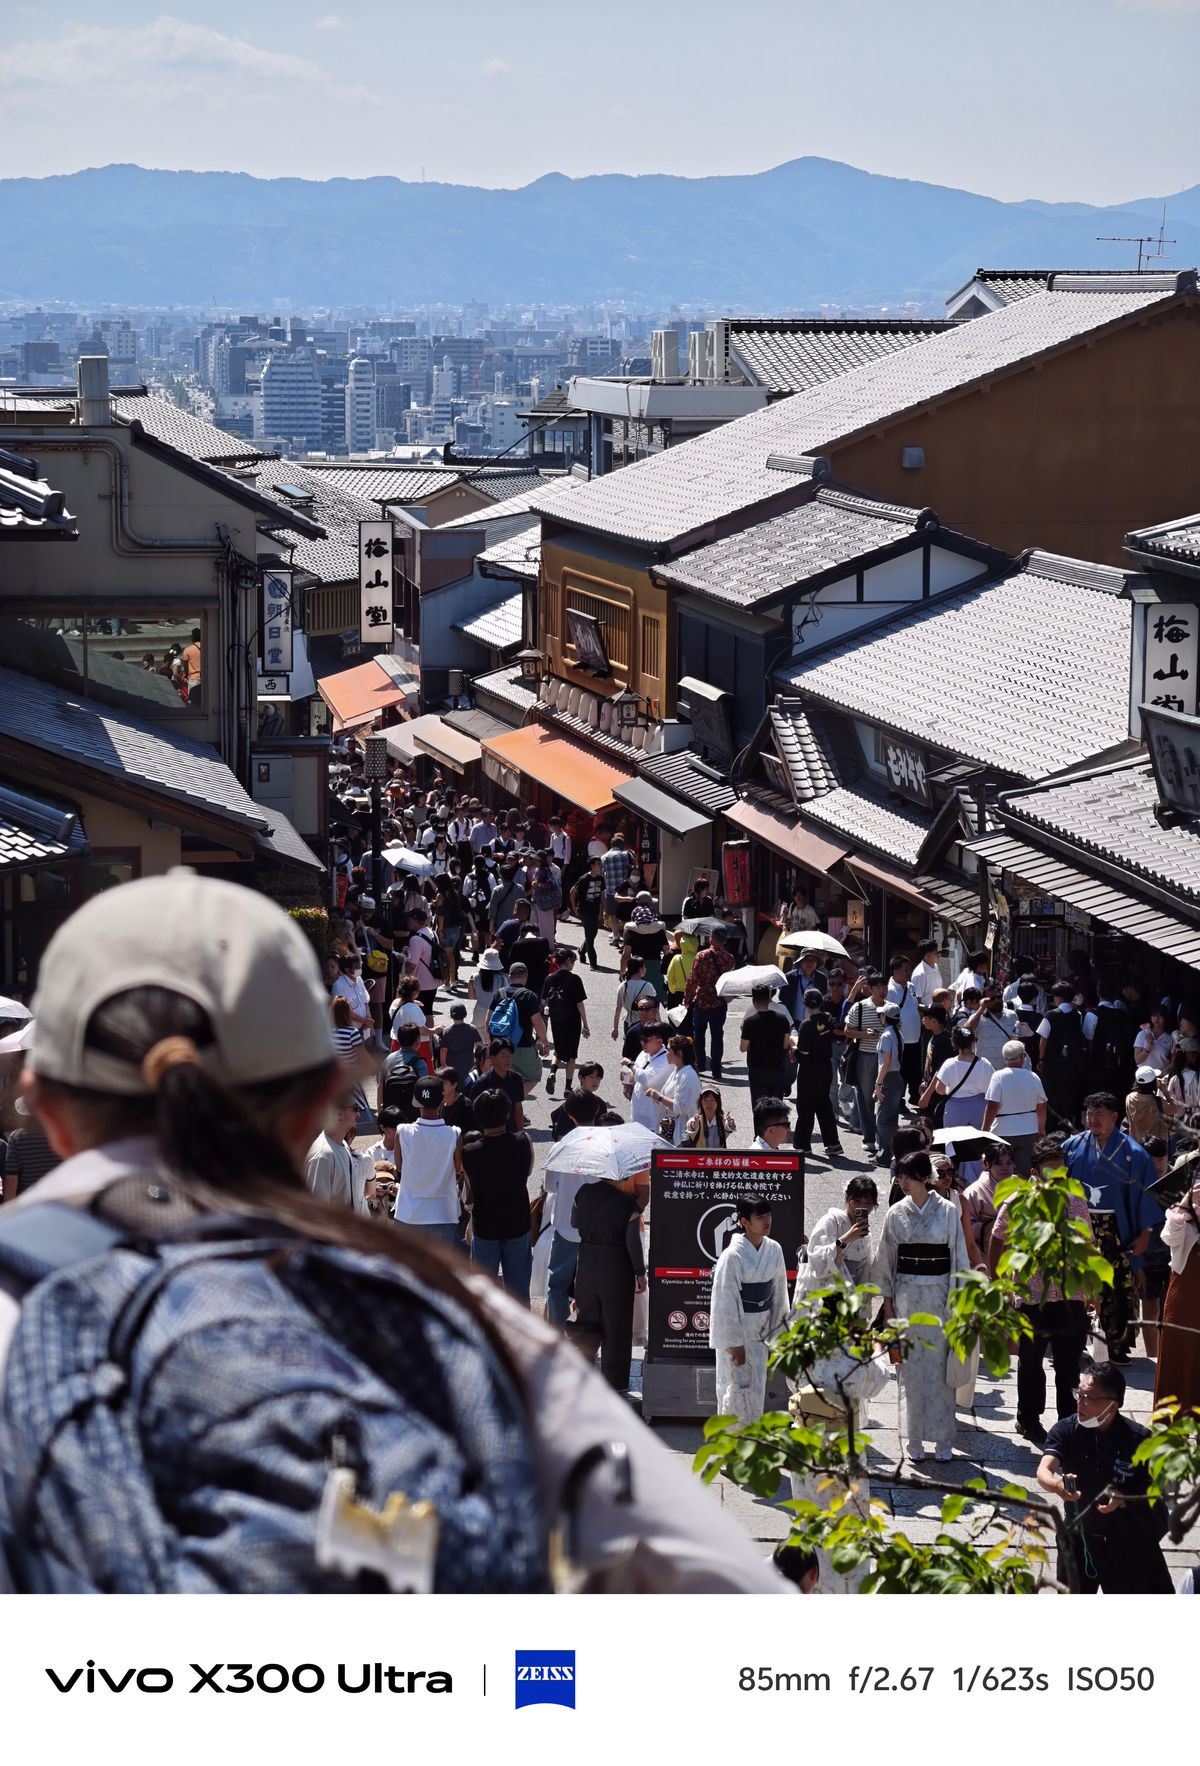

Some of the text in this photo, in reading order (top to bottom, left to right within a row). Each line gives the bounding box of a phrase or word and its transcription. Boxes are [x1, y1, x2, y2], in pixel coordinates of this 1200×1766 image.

[364, 537, 392, 628] 梅山堂
[267, 603, 283, 664] 朝日堂
[697, 1157, 760, 1167] ご参拝の皆様へ
